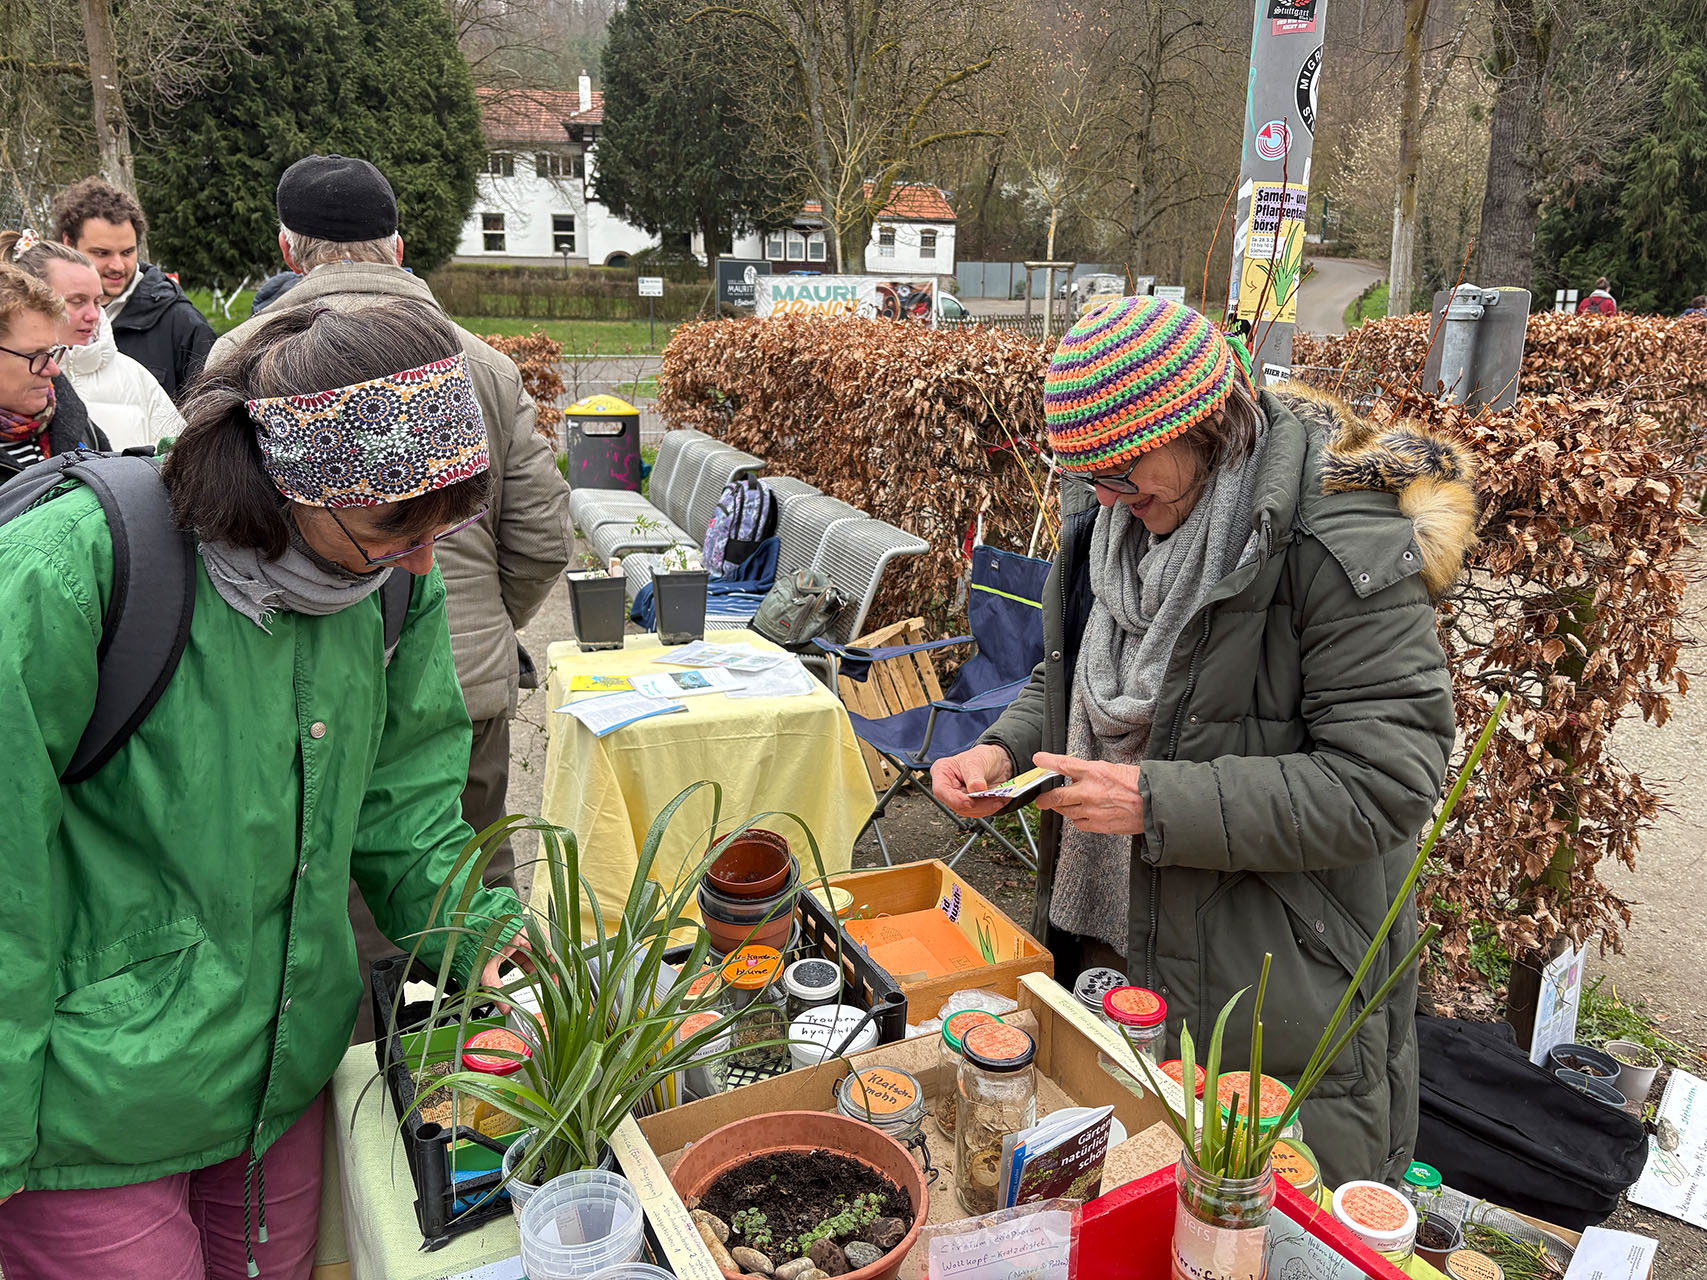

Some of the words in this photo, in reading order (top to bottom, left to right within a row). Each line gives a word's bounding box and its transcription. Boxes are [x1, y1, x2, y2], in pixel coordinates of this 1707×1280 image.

[1257, 189, 1294, 203] Samen-
[772, 285, 857, 301] MAURI
[771, 298, 859, 317] BRUNCH
[864, 1086, 898, 1105] mohn
[1077, 1117, 1112, 1146] Gärten
[1060, 1130, 1110, 1167] natürlich
[1078, 1146, 1108, 1171] schön
